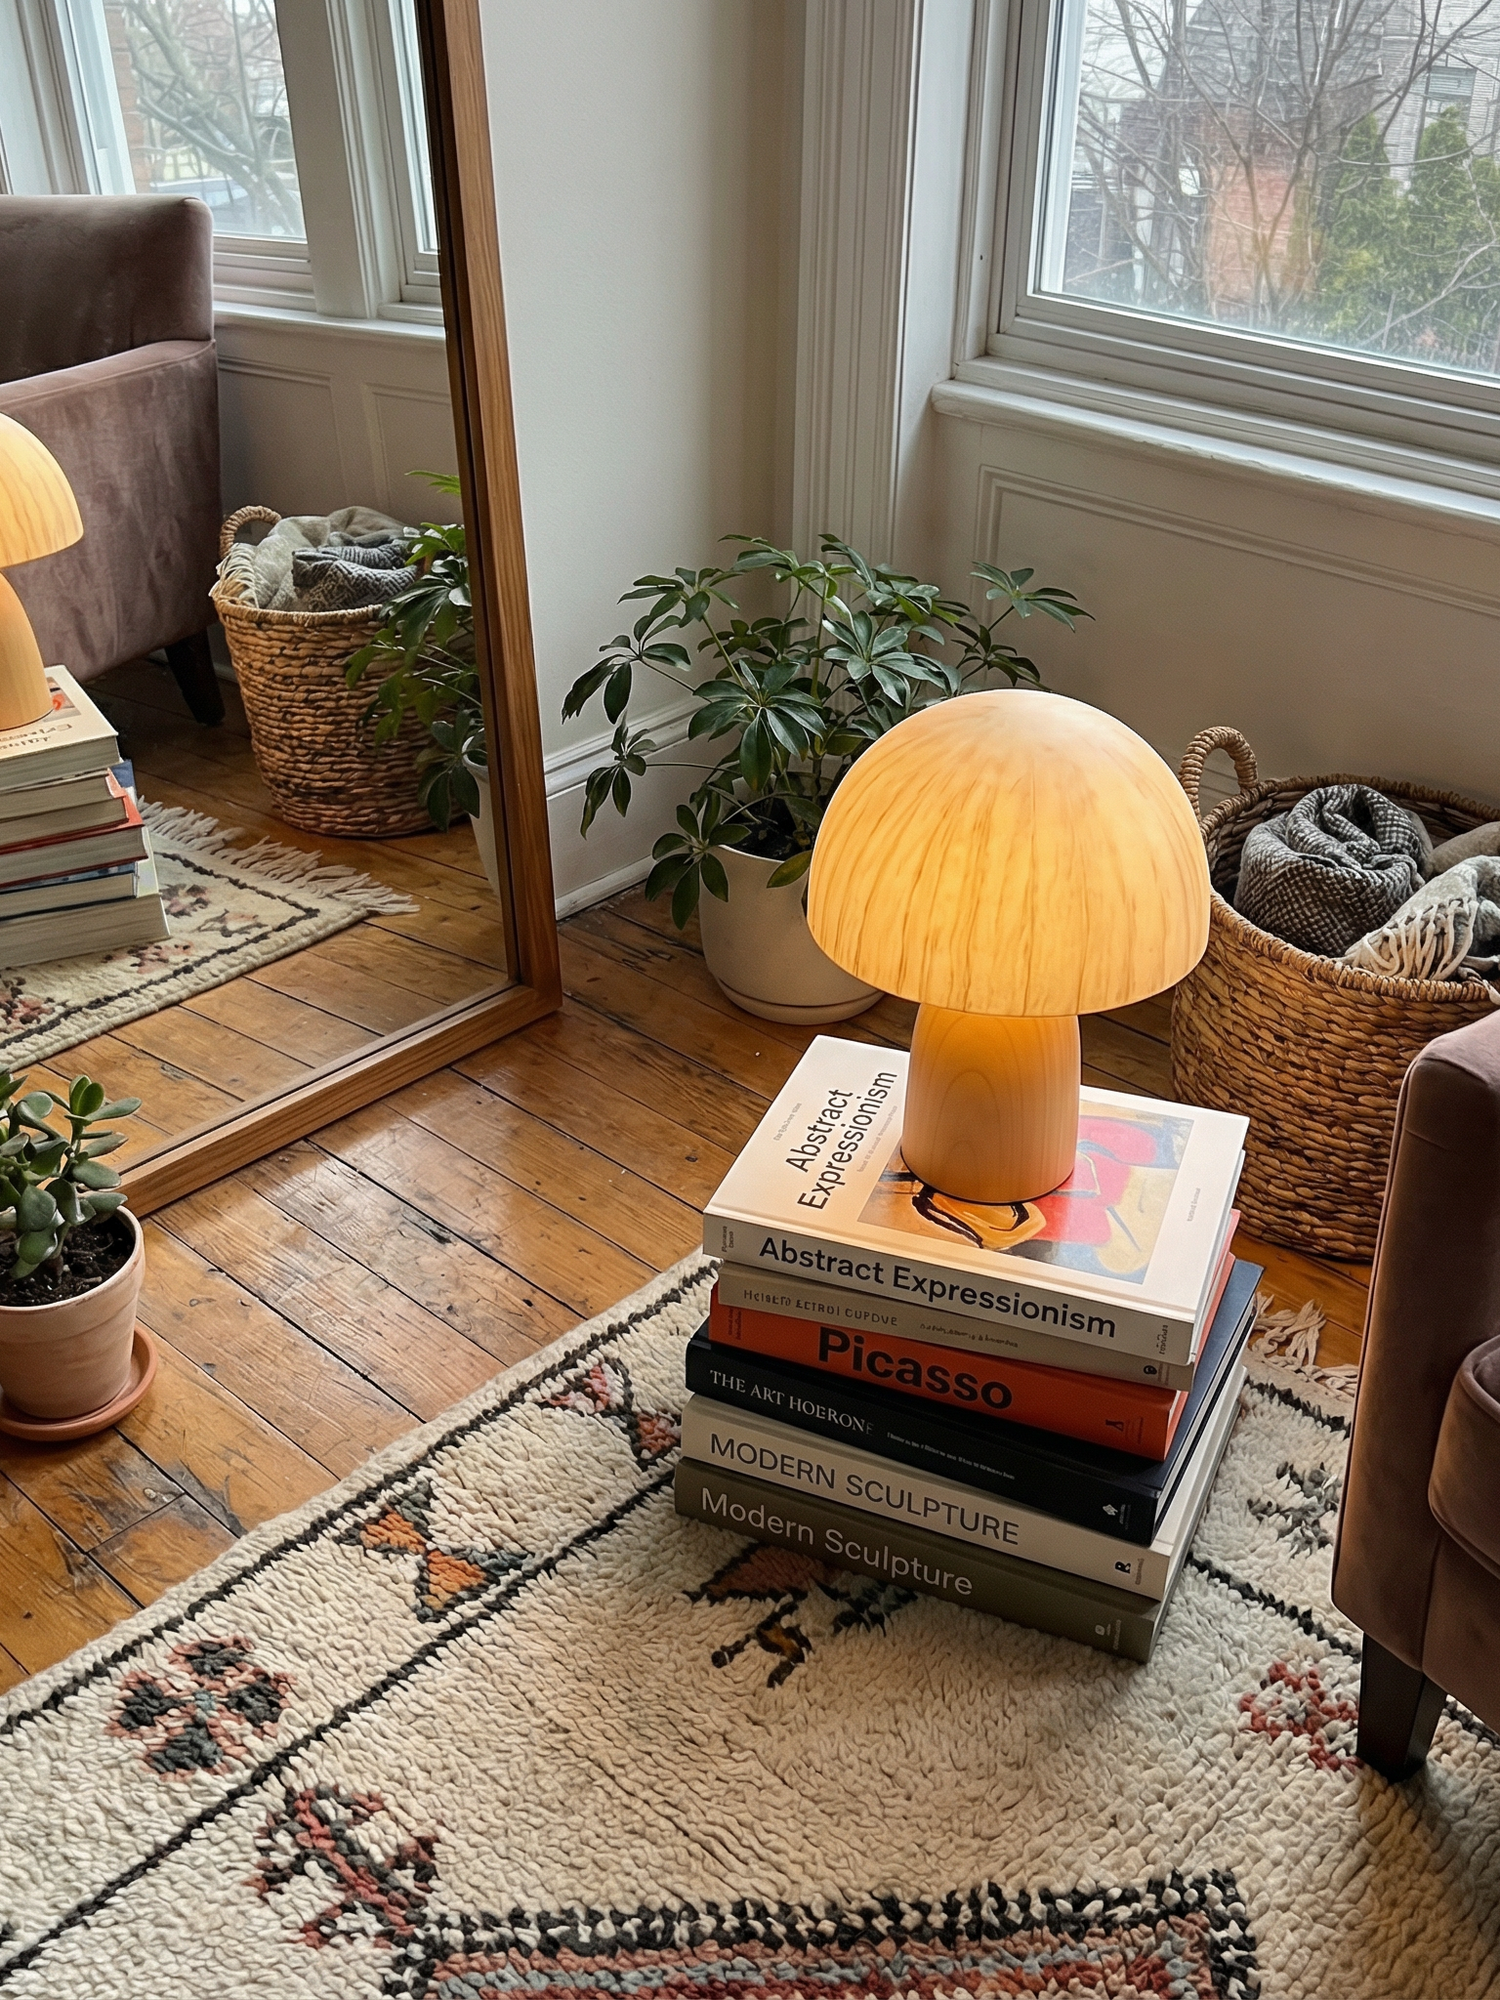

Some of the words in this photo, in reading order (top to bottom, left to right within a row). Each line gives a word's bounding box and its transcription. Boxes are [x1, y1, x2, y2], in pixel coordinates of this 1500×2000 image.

[785, 1089, 853, 1173] Abstract
[797, 1072, 898, 1210] Expressionism
[759, 1236, 885, 1284] Abstract
[892, 1264, 1116, 1339] Expressionism
[709, 1369, 746, 1394] THE
[750, 1384, 785, 1405] ART
[818, 1326, 1013, 1410] Picasso
[710, 1432, 836, 1489] MODERN
[845, 1474, 1020, 1546] SCULPTURE
[701, 1487, 815, 1545] Modern
[824, 1528, 973, 1596] Sculpture
